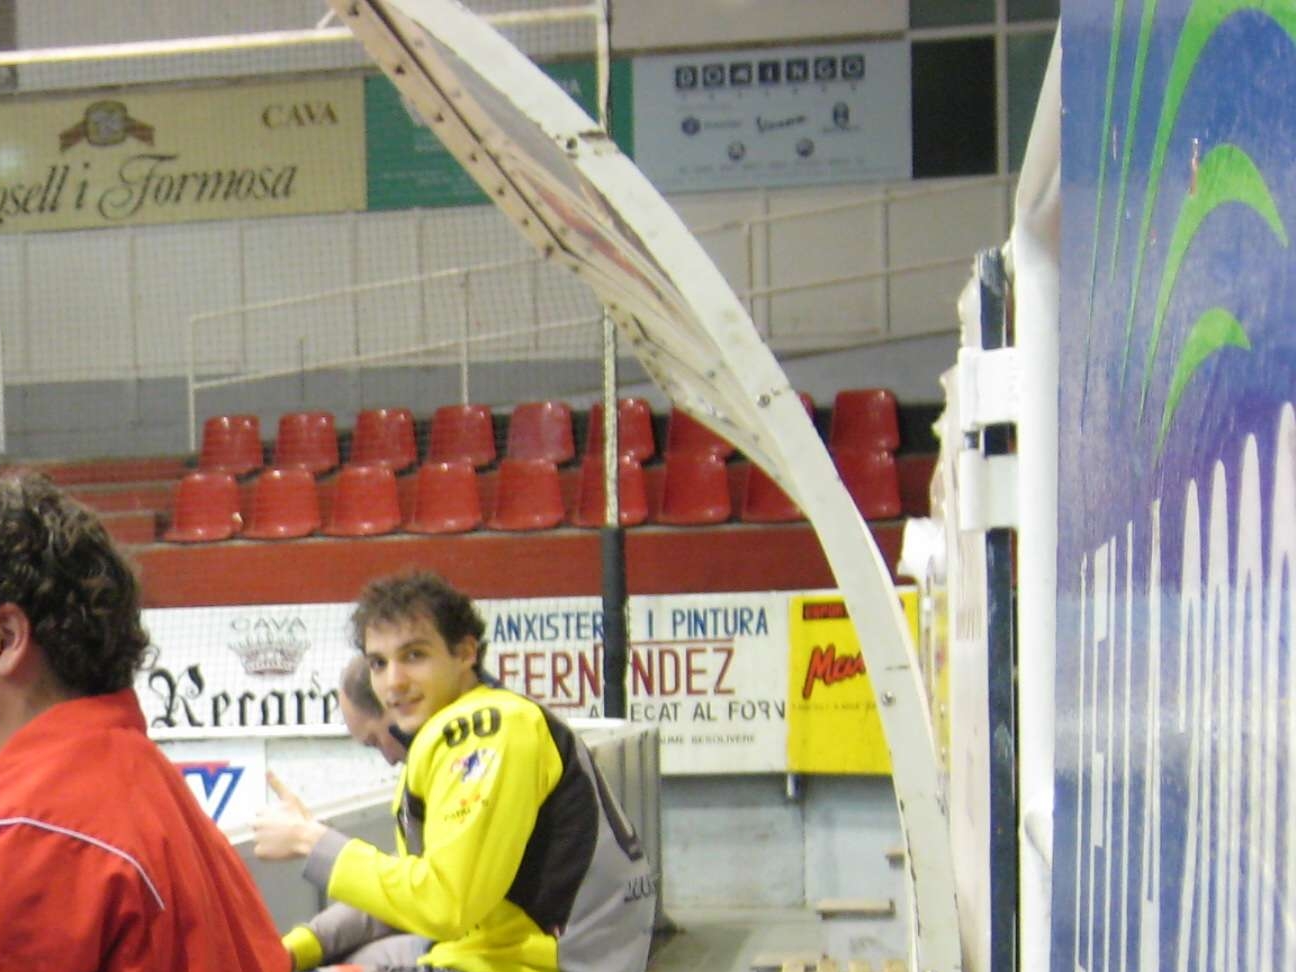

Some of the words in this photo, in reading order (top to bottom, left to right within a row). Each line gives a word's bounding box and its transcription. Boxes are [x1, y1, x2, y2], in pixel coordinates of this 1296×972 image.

[262, 103, 339, 130] CAVA
[98, 154, 299, 220] Formosa
[231, 616, 307, 632] CAVA
[671, 607, 769, 638] PINTURA
[498, 645, 736, 701] FERNNDEZ
